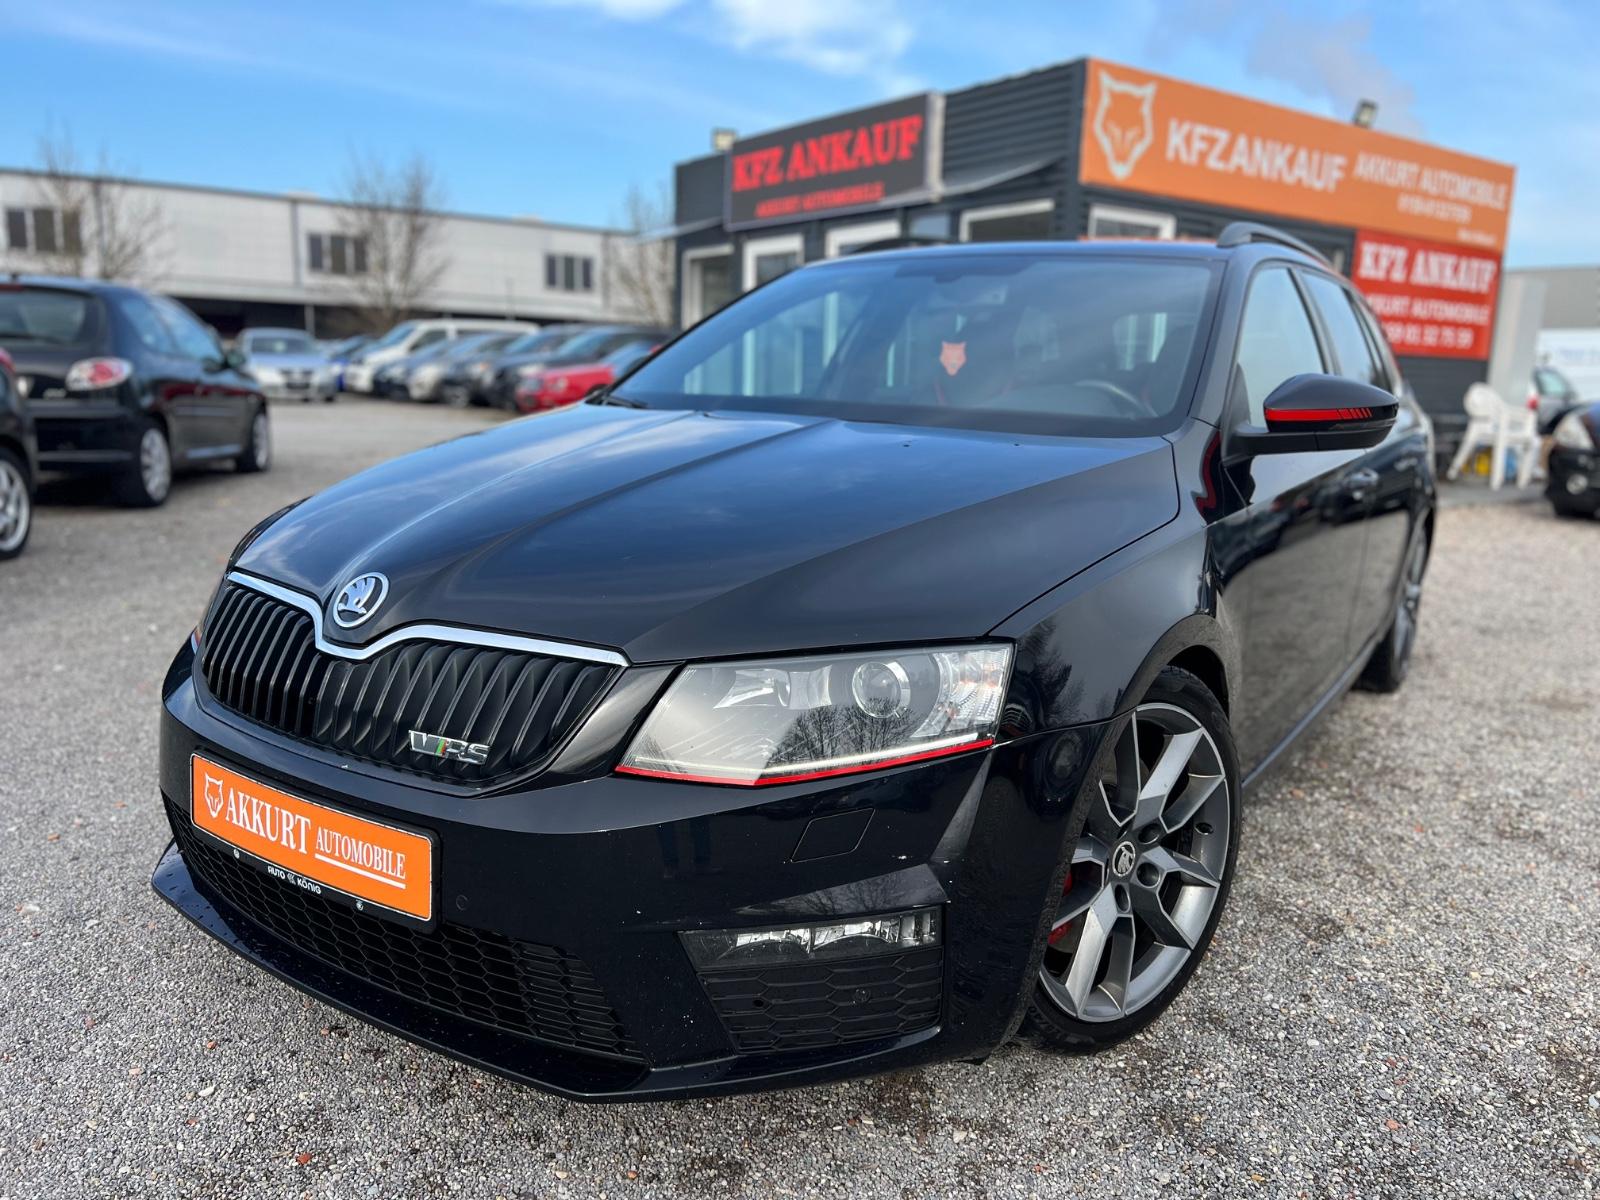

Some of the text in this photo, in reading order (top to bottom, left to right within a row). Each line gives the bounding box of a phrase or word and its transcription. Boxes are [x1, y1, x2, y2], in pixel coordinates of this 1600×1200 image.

[732, 114, 924, 192] KFZ ANKAUF
[1358, 240, 1498, 295] KFZ ANKAUF
[225, 787, 406, 880] AKKURT AUTOMOBILE
[267, 865, 286, 880] AUTO
